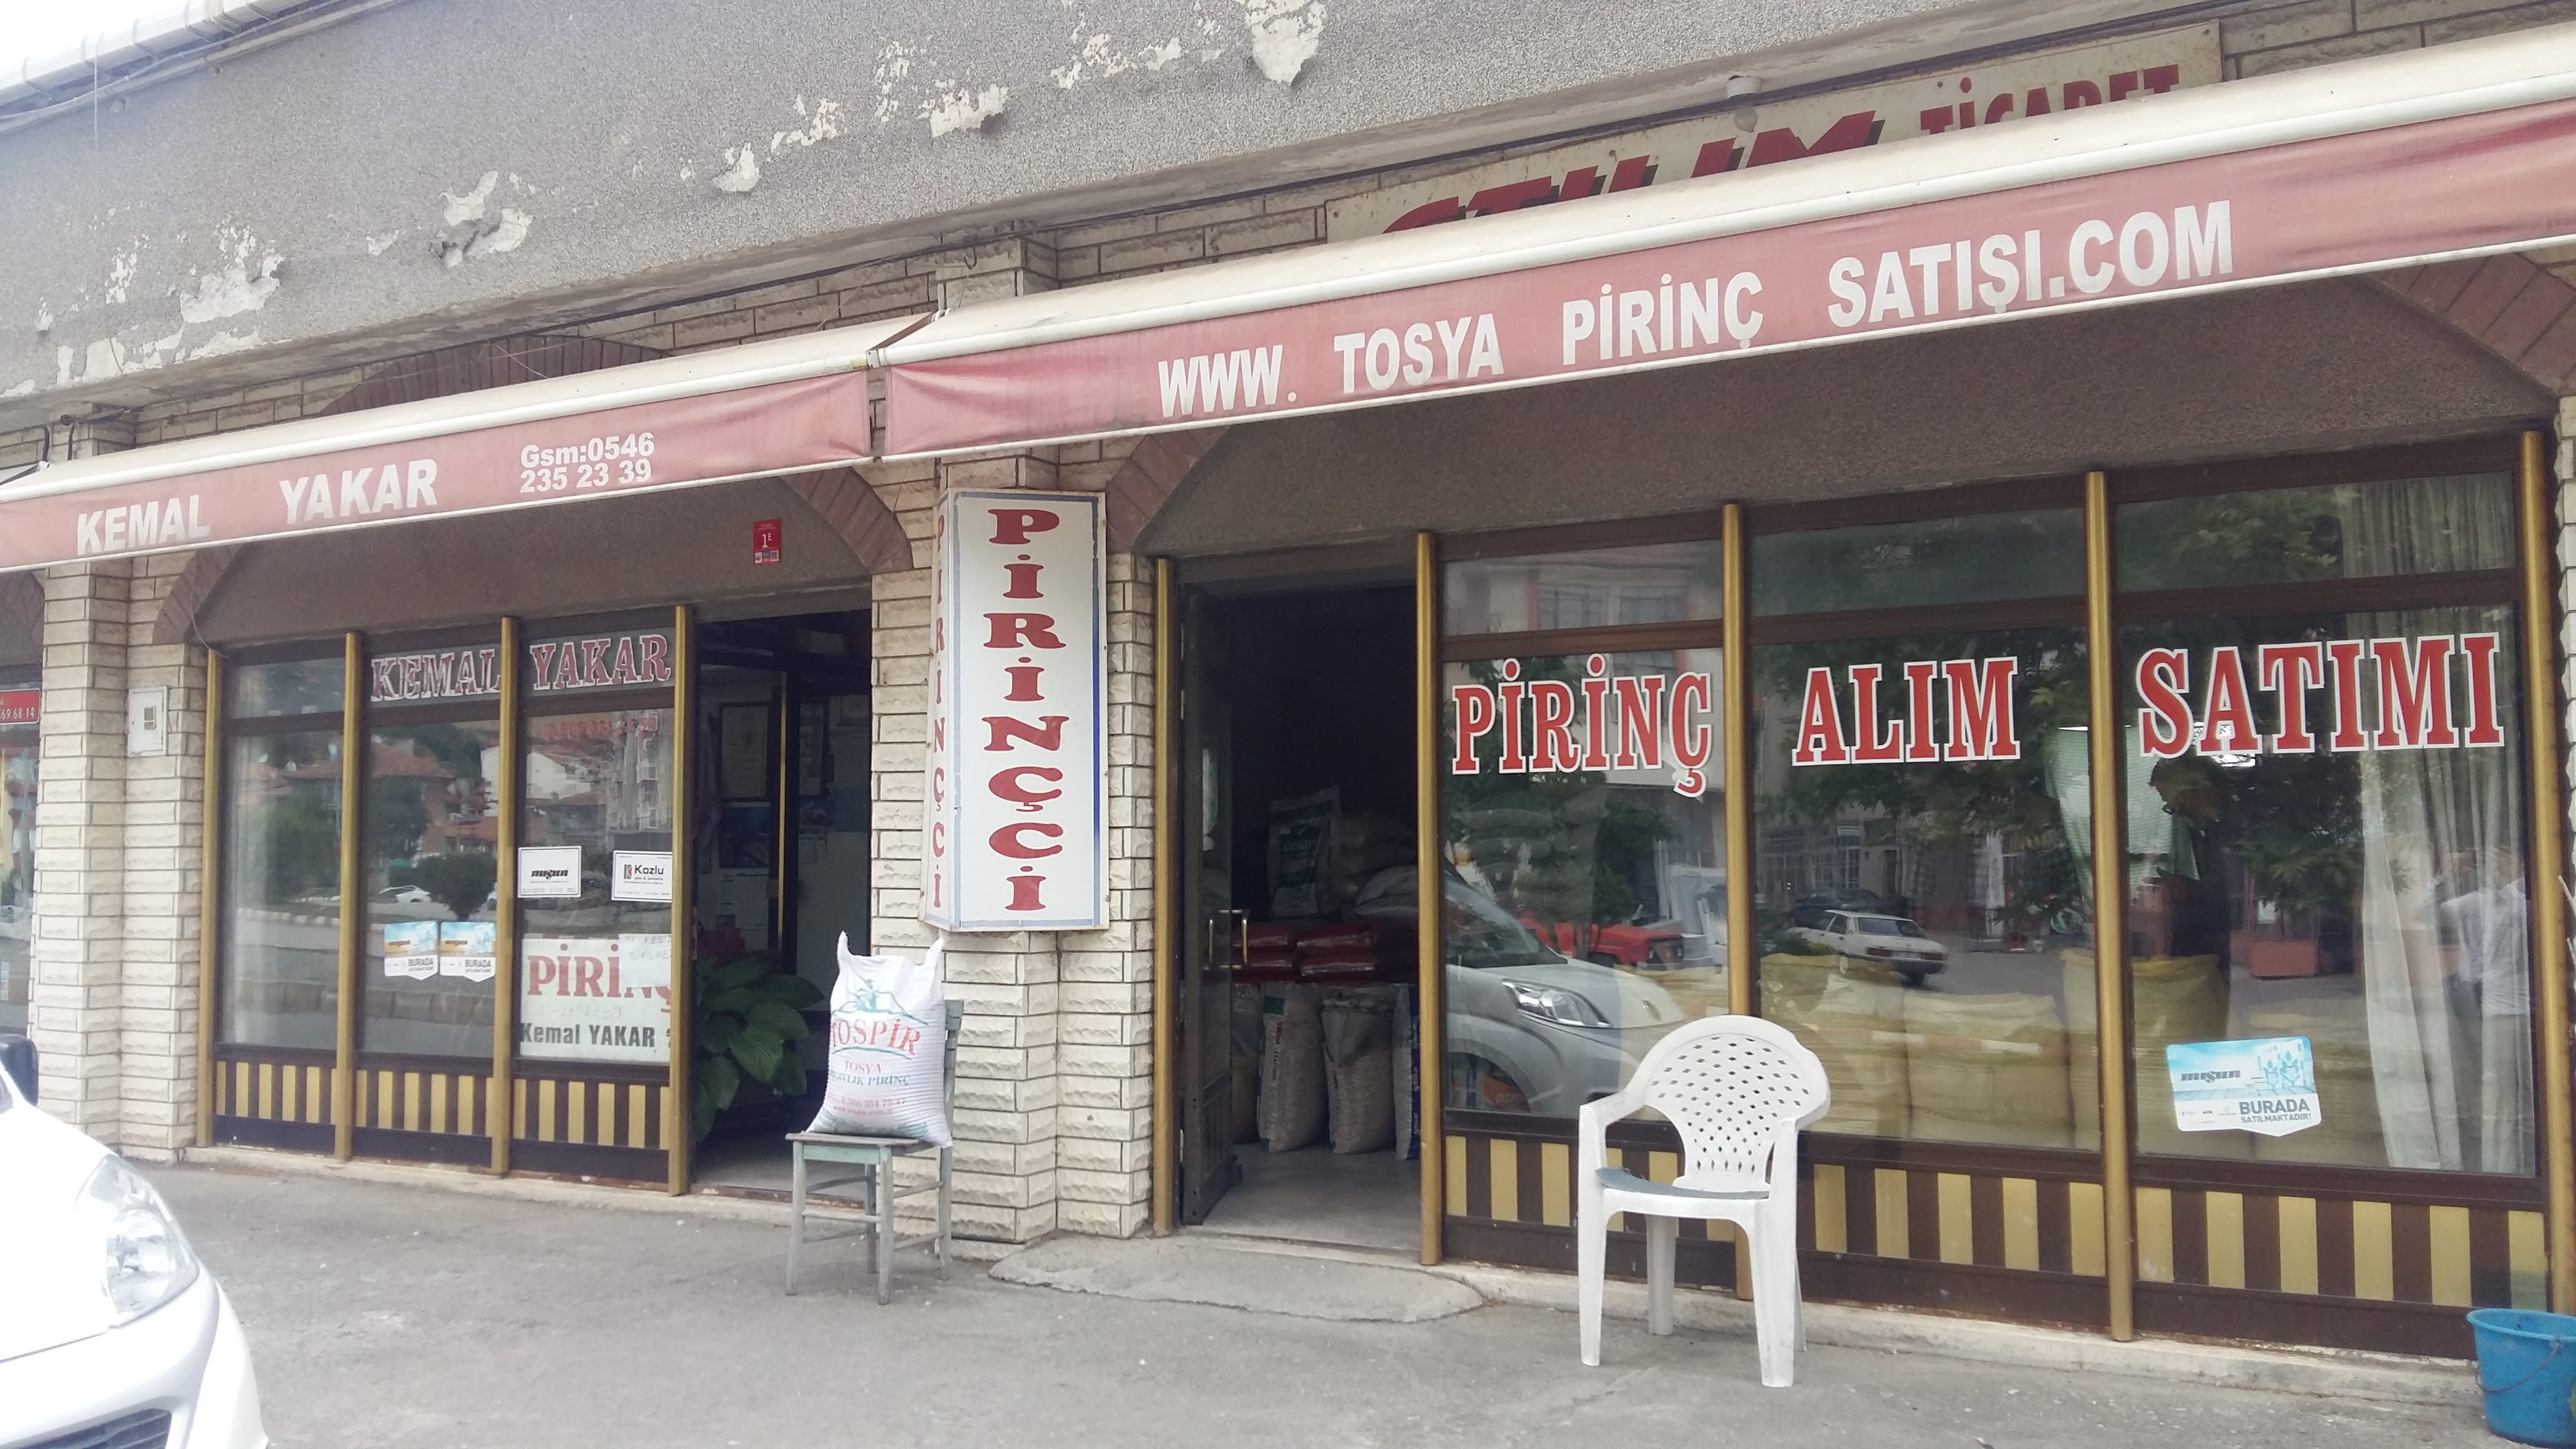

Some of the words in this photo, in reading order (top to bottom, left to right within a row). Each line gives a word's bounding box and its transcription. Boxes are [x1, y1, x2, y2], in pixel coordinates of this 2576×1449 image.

[1334, 314, 1504, 394] TOSYA
[1563, 271, 1764, 366] PİRİNÇ
[1828, 200, 2233, 329] SATIŞI.COM
[520, 432, 655, 469] Gsm:0546
[520, 463, 567, 493] 235
[577, 461, 608, 489] 23
[619, 459, 652, 484] 39
[77, 494, 210, 557] KEMAL
[279, 459, 437, 524] YAKAR
[369, 648, 500, 702] KEMAL
[530, 633, 671, 691] YAKAR
[0, 708, 11, 720] 69
[13, 708, 22, 719] 68
[26, 707, 34, 718] 14
[1451, 653, 1712, 798] PİRİNÇ
[1791, 656, 2021, 767] ALIM
[2135, 632, 2505, 759] SATIMI
[635, 864, 664, 875] Kozlu
[408, 957, 434, 967] BURADA
[465, 959, 491, 968] BURADA
[527, 943, 671, 1013] PİRİ
[521, 1022, 580, 1045] Kemal
[589, 1024, 655, 1048] YAKAR
[844, 1060, 882, 1075] TOSYA
[2239, 1098, 2311, 1115] BURADA
[2241, 1113, 2311, 1123] SATILMAKTADIR!
